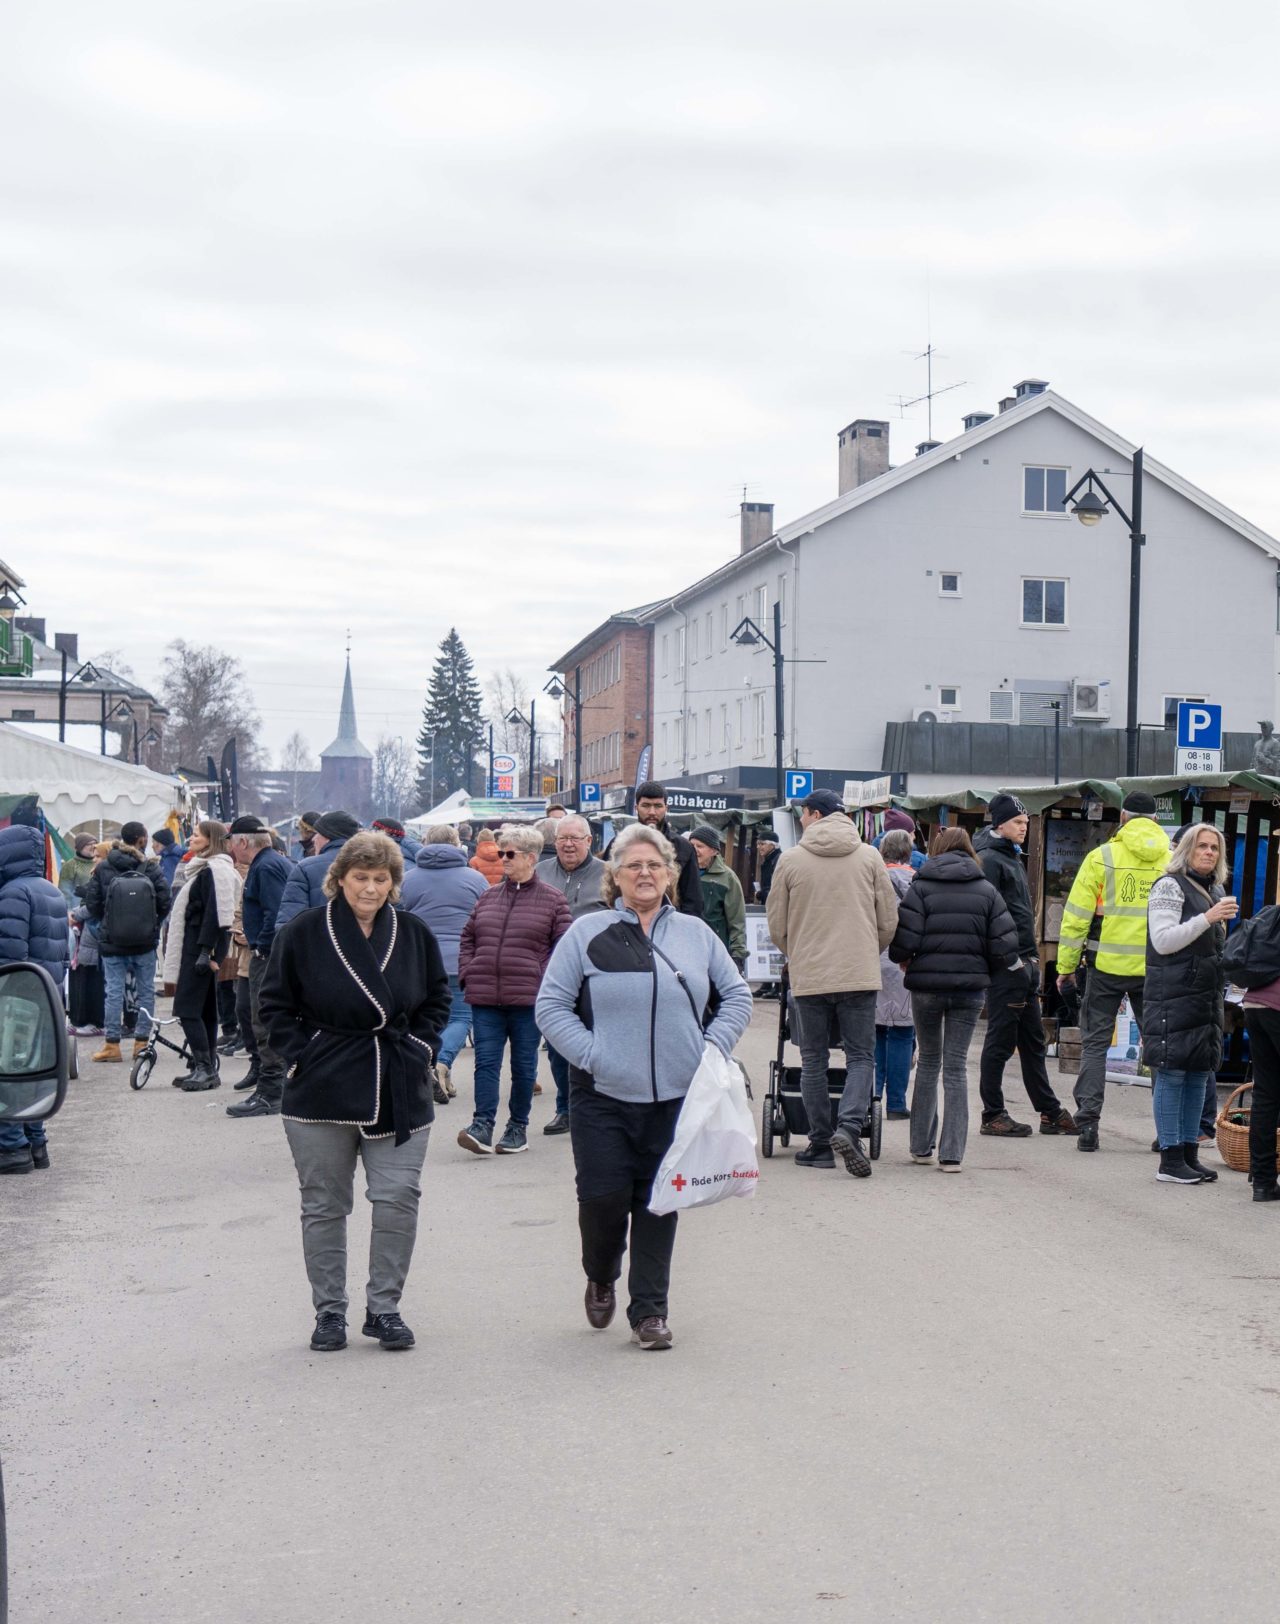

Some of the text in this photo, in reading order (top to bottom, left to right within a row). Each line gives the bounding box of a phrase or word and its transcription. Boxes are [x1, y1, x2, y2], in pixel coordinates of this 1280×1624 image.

[1188, 708, 1212, 743] P
[584, 784, 596, 800] P
[792, 774, 806, 796] P
[713, 1173, 732, 1183] Kors
